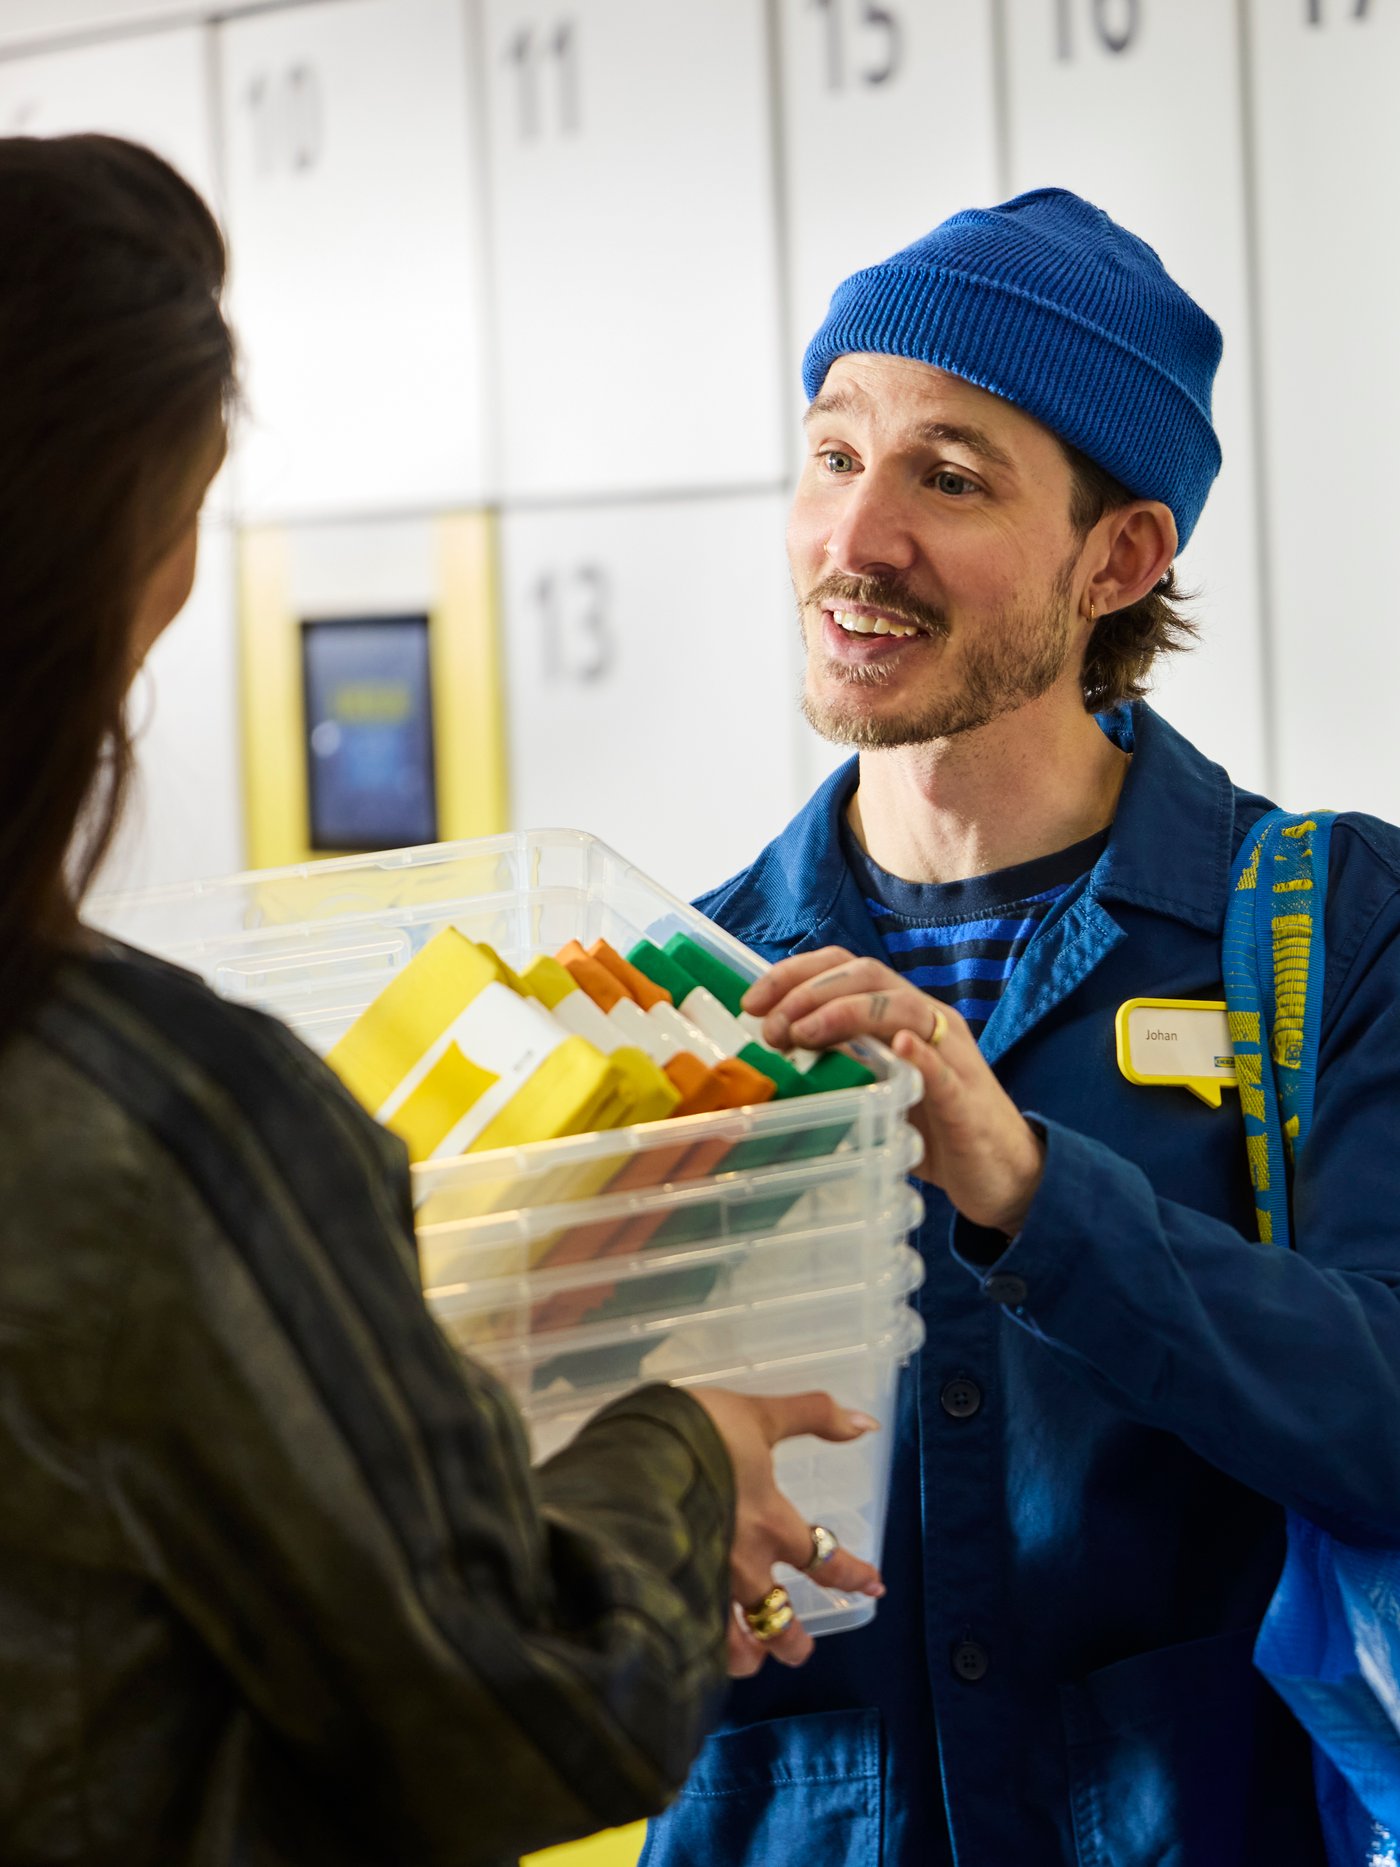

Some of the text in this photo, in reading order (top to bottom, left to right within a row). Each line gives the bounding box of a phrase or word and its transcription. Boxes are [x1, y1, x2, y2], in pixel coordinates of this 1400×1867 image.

[508, 20, 582, 140] 11
[807, 0, 904, 92] 15
[245, 60, 323, 176] 10
[531, 562, 617, 687] 13
[1145, 1029, 1178, 1041] Johan
